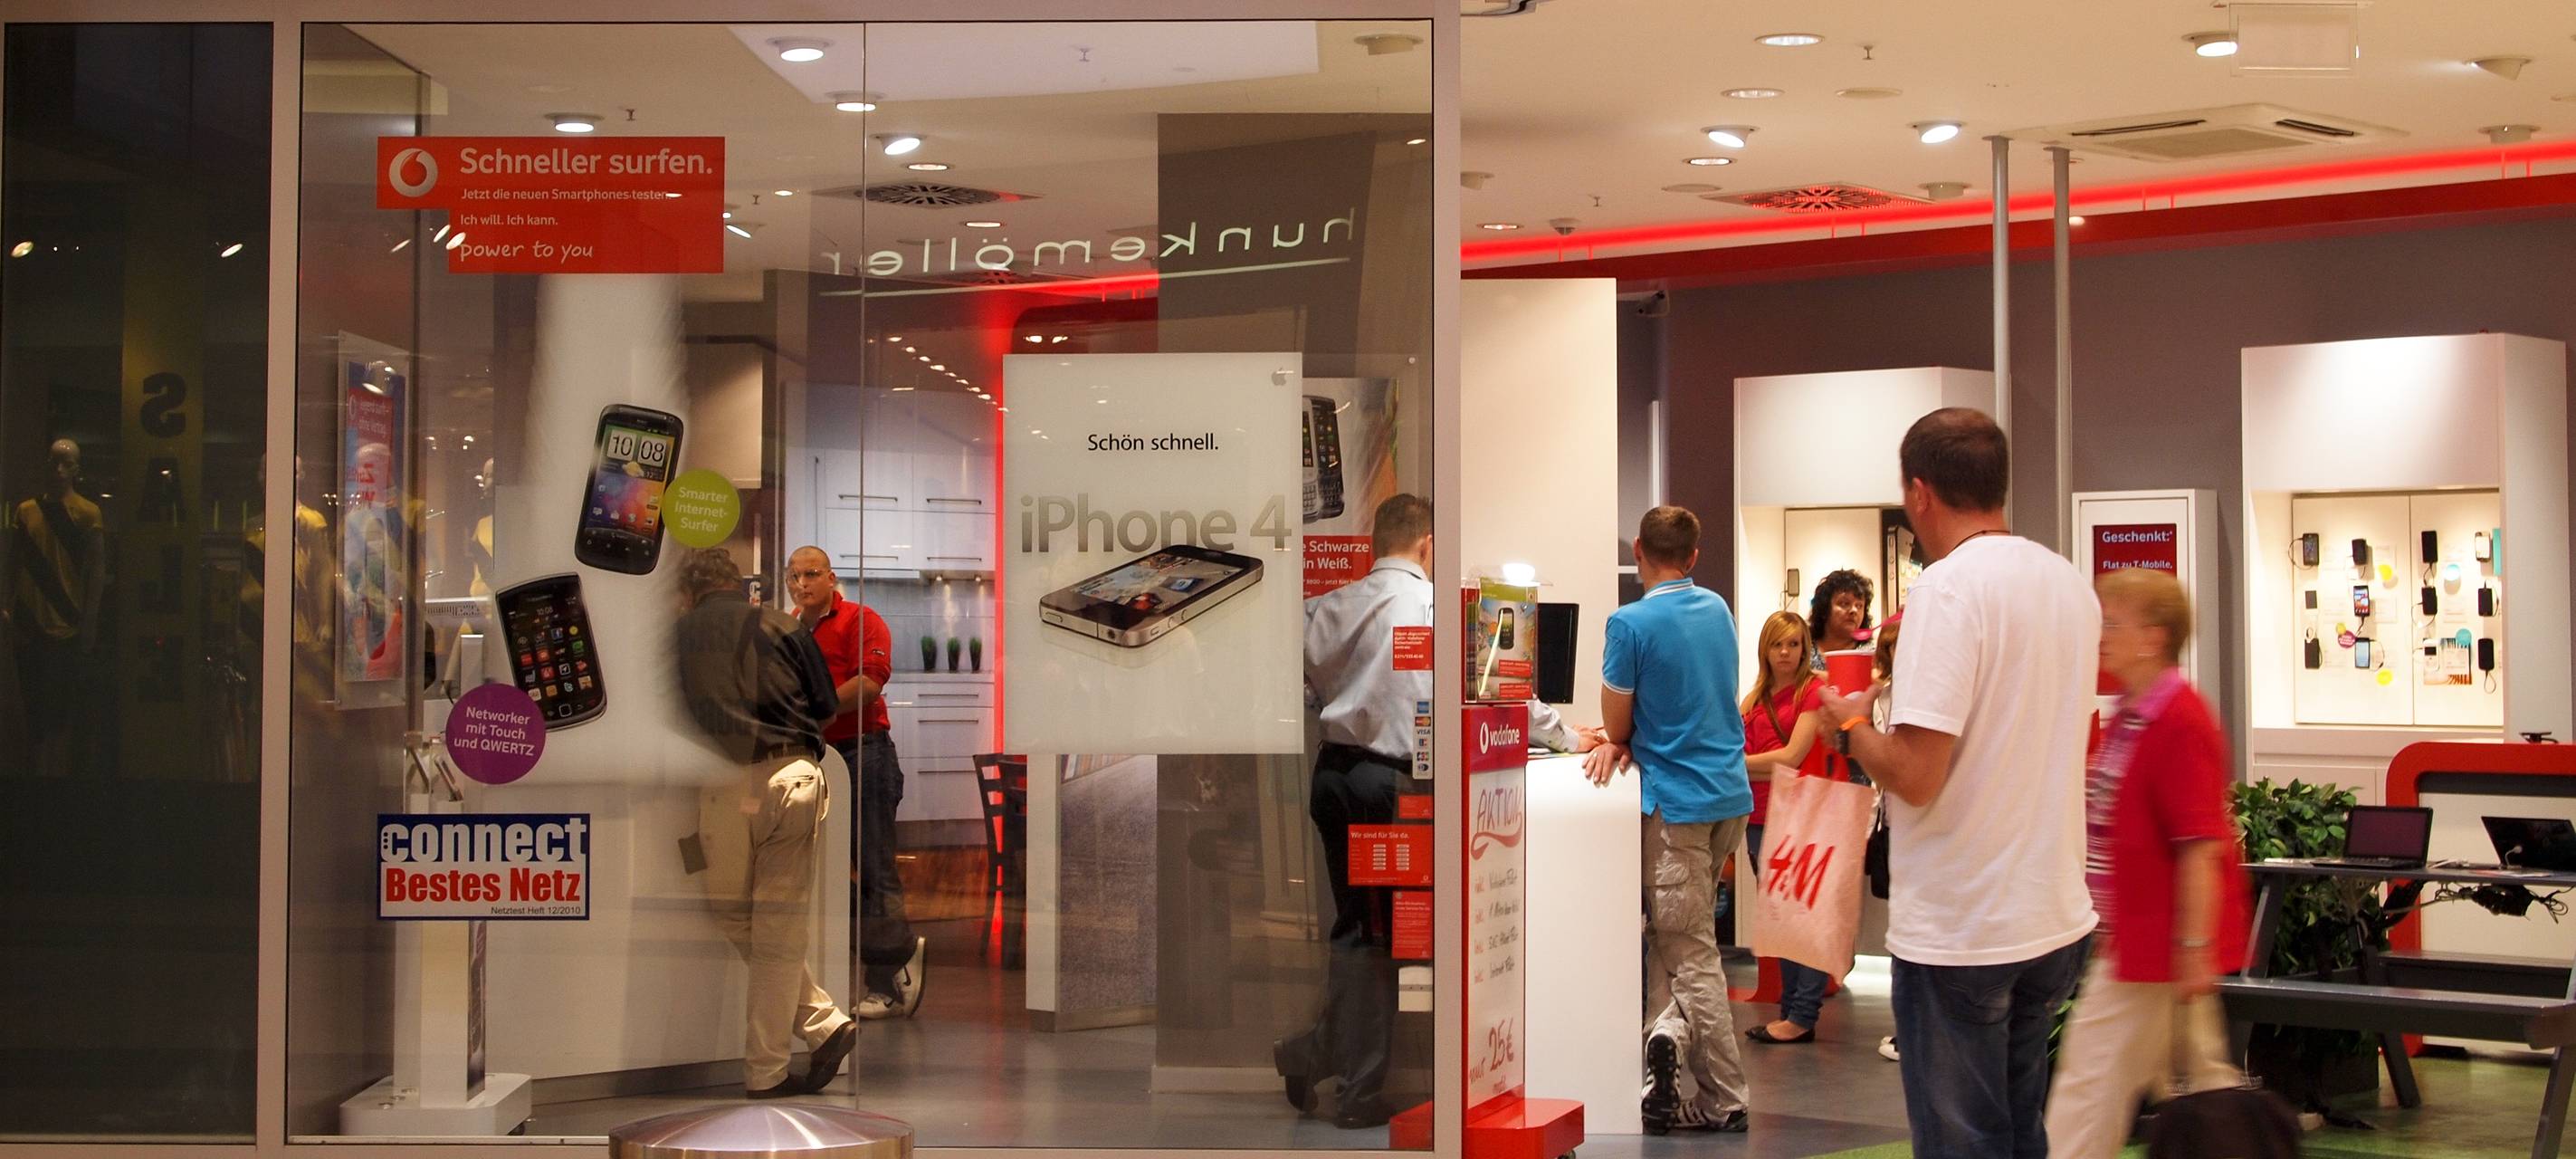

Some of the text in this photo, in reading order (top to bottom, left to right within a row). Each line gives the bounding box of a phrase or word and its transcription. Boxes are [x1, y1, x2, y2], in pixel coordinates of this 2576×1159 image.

[460, 148, 713, 175] Schneller surfen.
[461, 188, 491, 201] Jetzt
[492, 188, 510, 200] die
[512, 191, 549, 200] neuen
[551, 188, 630, 204] Smartphones
[460, 215, 558, 226] Ich will. Ich kann.
[460, 240, 594, 263] power to you
[613, 436, 665, 463] 10 08
[1087, 433, 1219, 452] Schön schnell.
[678, 487, 729, 503] Smarter
[674, 502, 728, 519] Internet-
[680, 518, 719, 532] Surfer
[1020, 492, 1293, 554] iPhone 4
[1309, 541, 1369, 553] Schwarze
[1303, 557, 1352, 570] in Weiß.
[466, 706, 531, 725] Networker
[465, 723, 527, 741] mit Touch
[1489, 724, 1521, 746] vodafone
[453, 738, 536, 757] und QWERTZ
[380, 818, 587, 862] connect
[386, 867, 581, 902] Bestes Netz
[491, 906, 581, 915] Netztest Heft 12/2010
